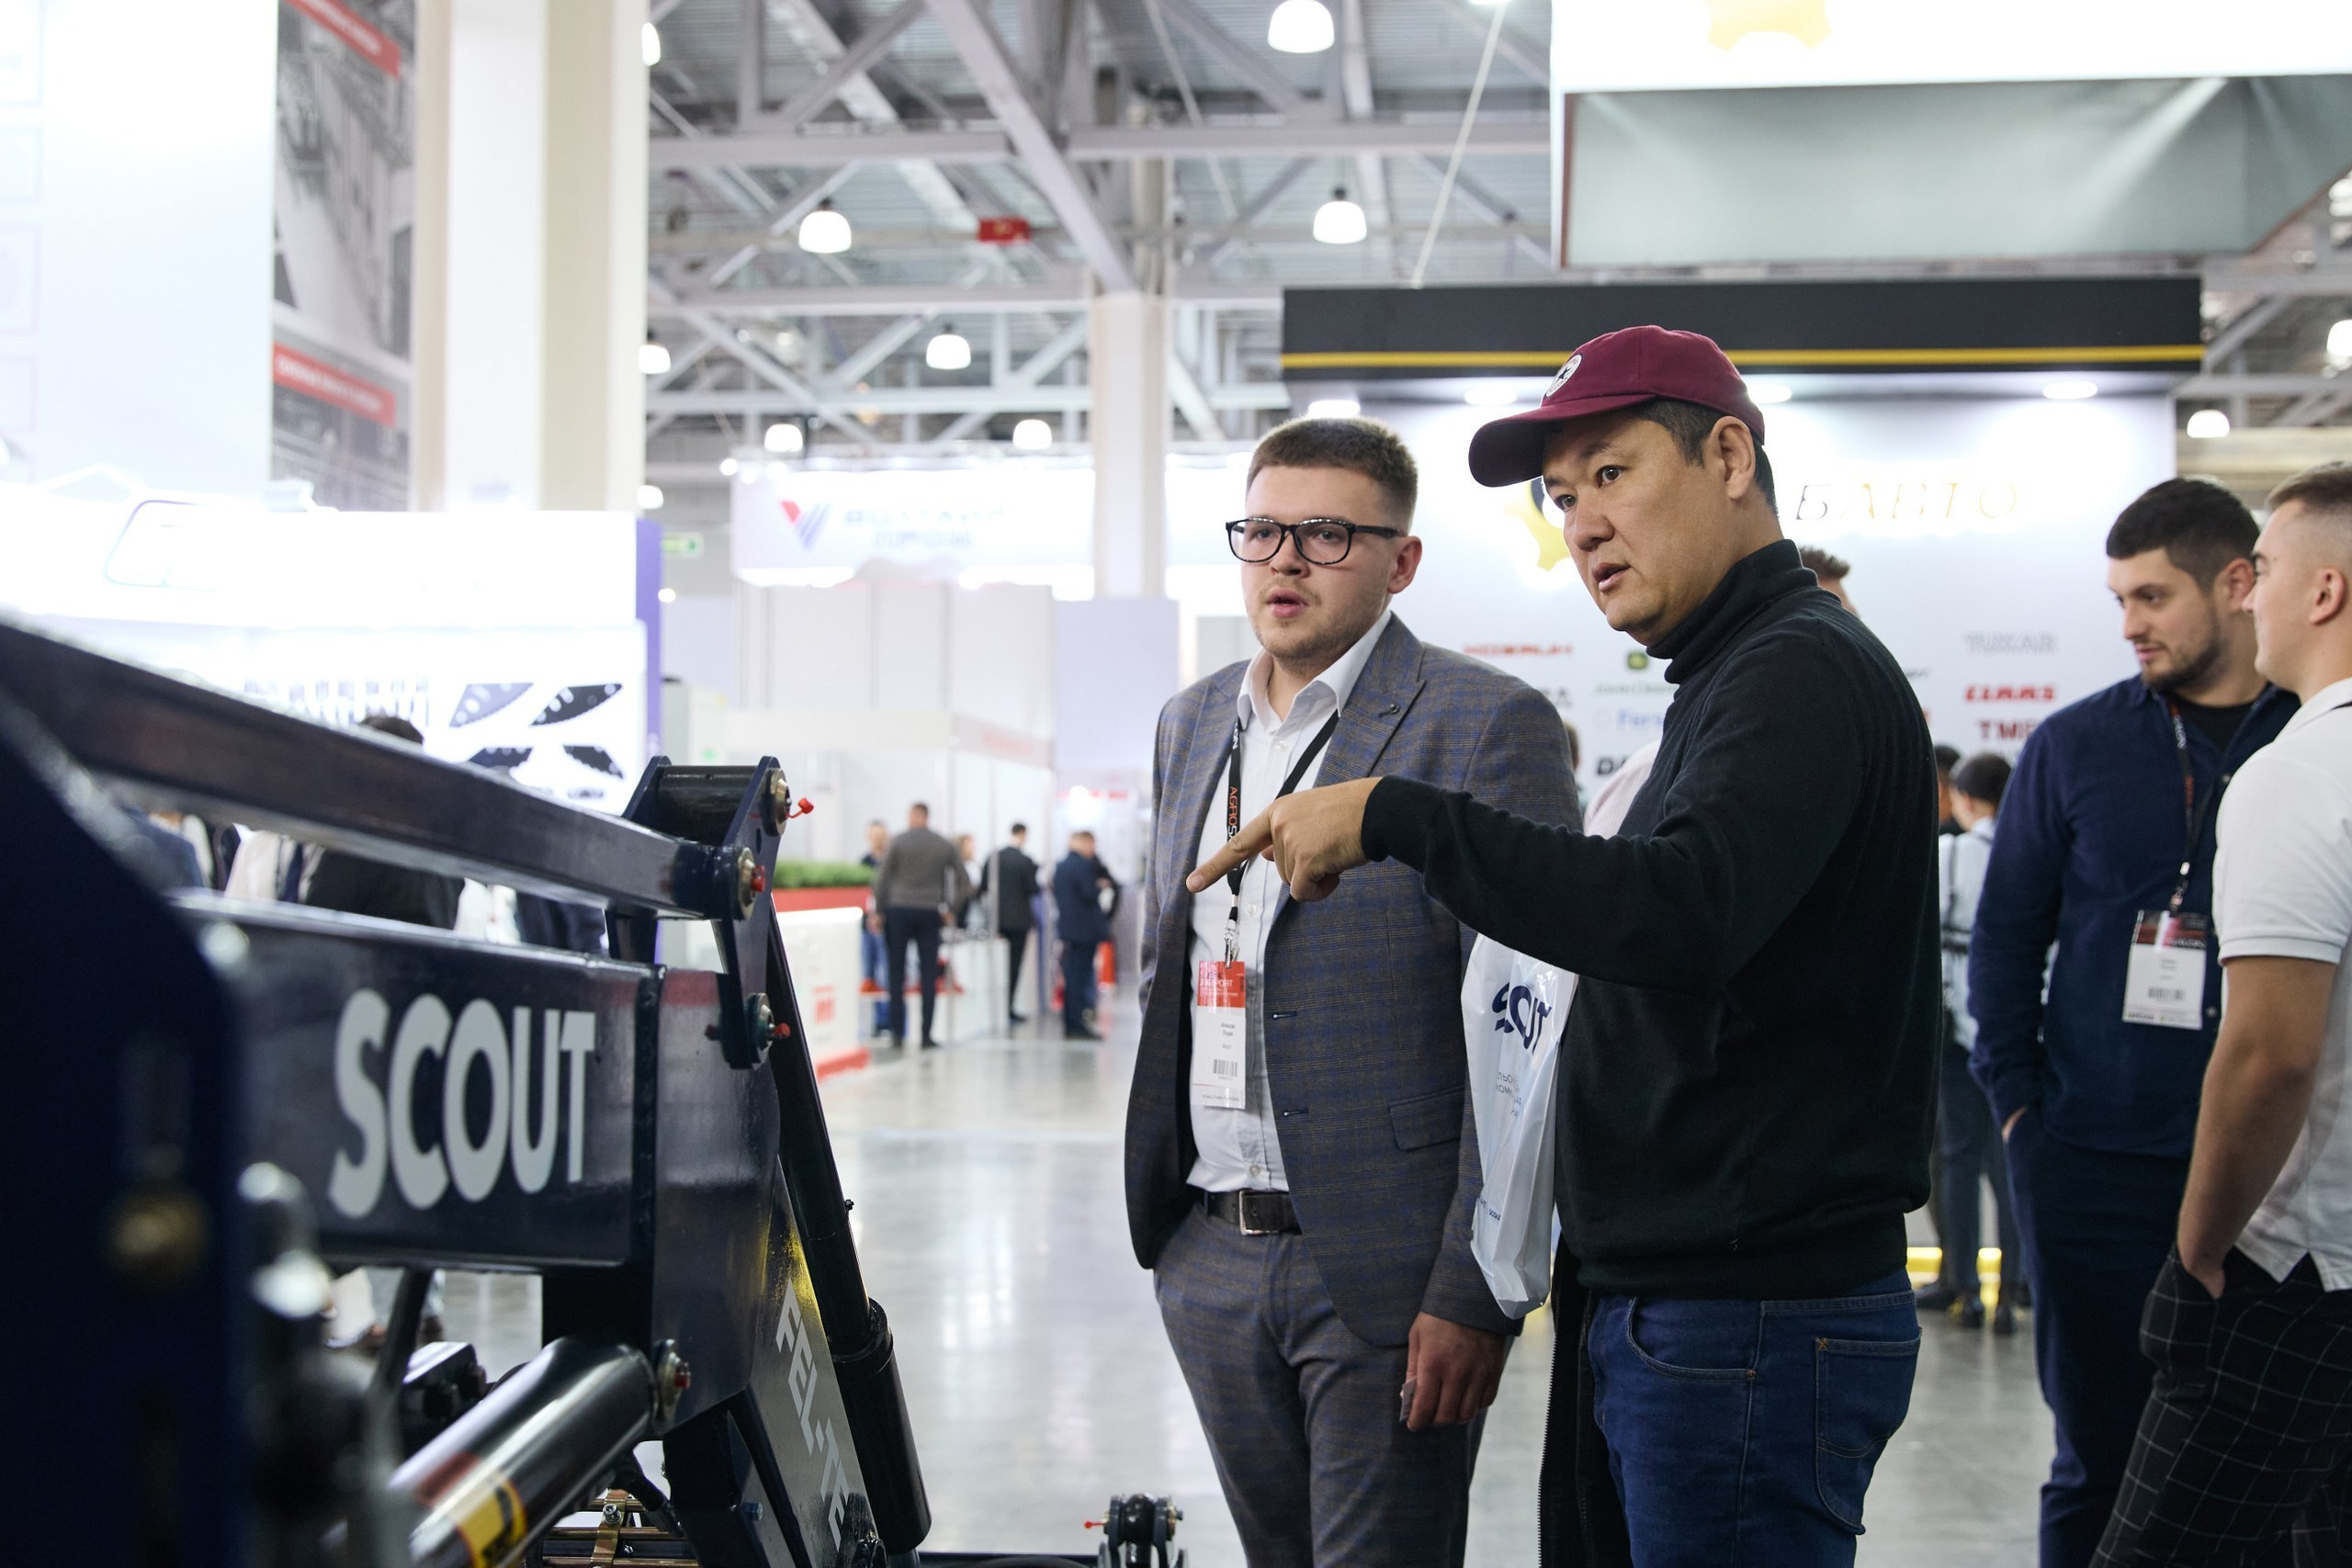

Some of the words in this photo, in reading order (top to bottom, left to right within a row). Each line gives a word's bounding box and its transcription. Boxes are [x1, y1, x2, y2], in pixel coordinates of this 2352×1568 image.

[1964, 684, 2056, 703] CLAAS
[1227, 786, 1238, 839] AGROS
[328, 987, 596, 1218] SCOUT
